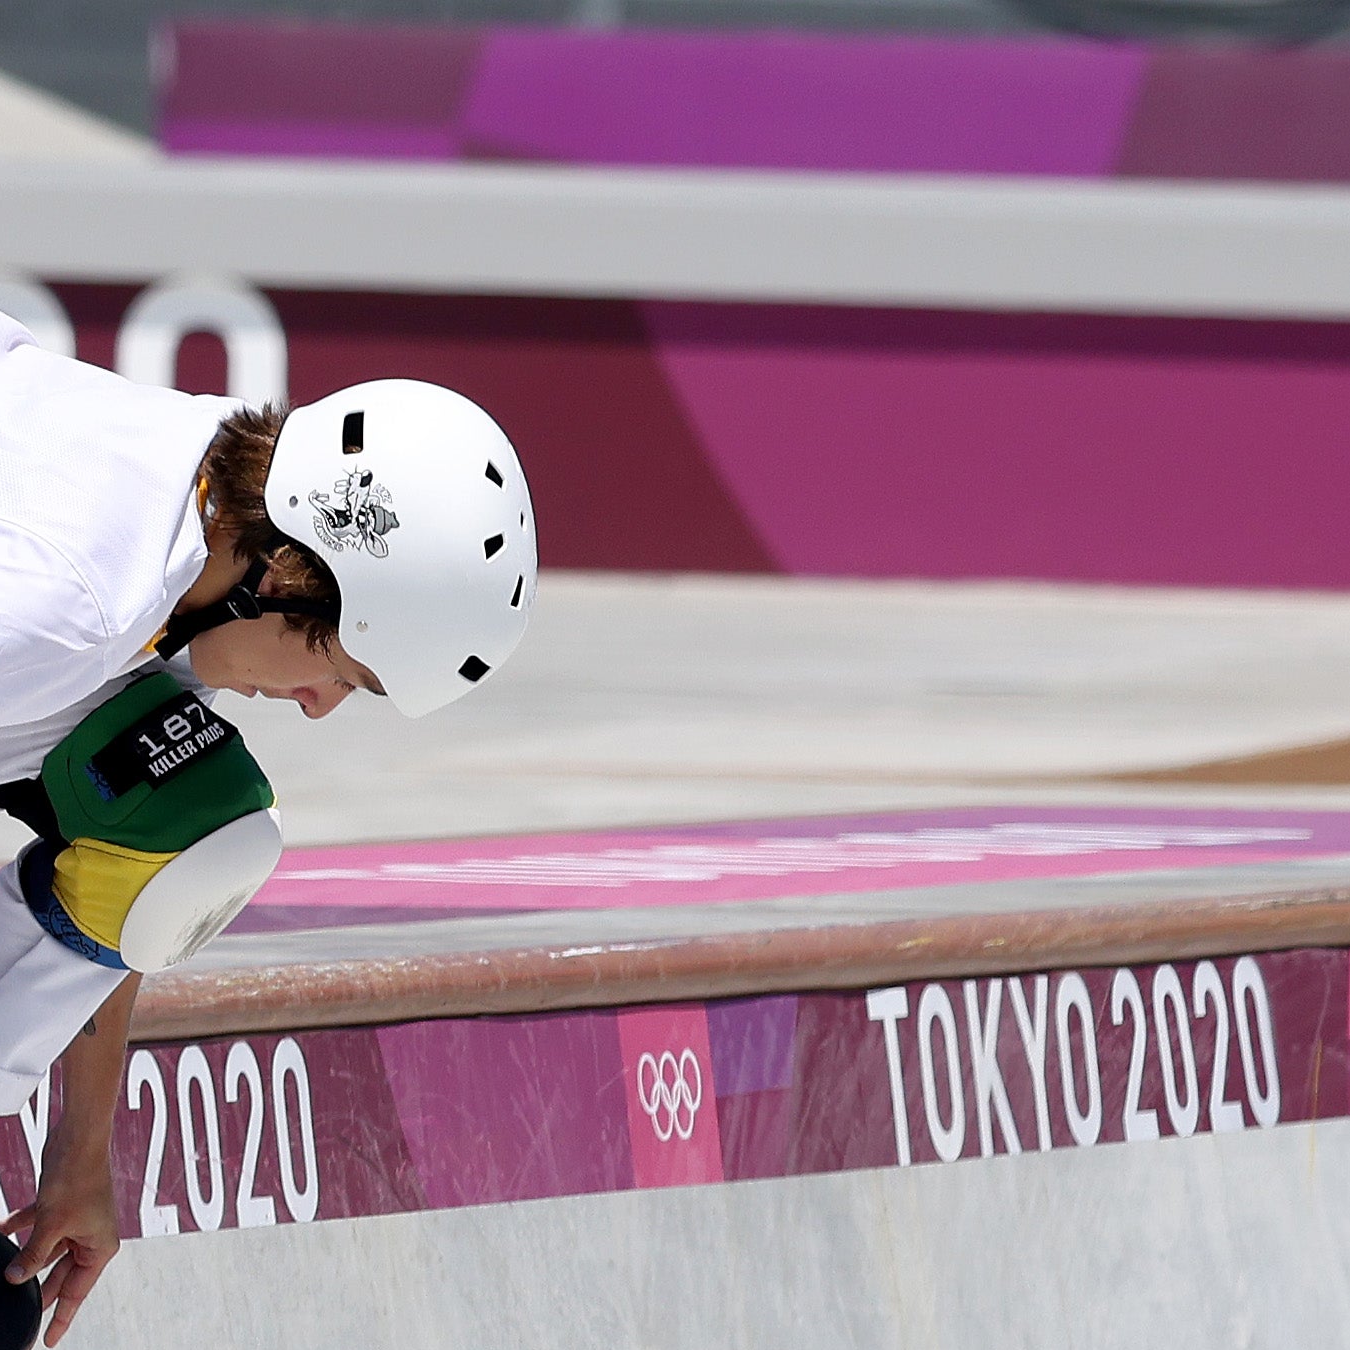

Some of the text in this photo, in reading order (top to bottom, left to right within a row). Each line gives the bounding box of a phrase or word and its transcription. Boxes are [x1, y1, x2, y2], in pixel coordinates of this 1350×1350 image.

[139, 703, 205, 757] 187
[148, 722, 225, 777] KILLER PADS
[867, 955, 1281, 1166] TOKYO 2020
[127, 1037, 319, 1237] 2020
